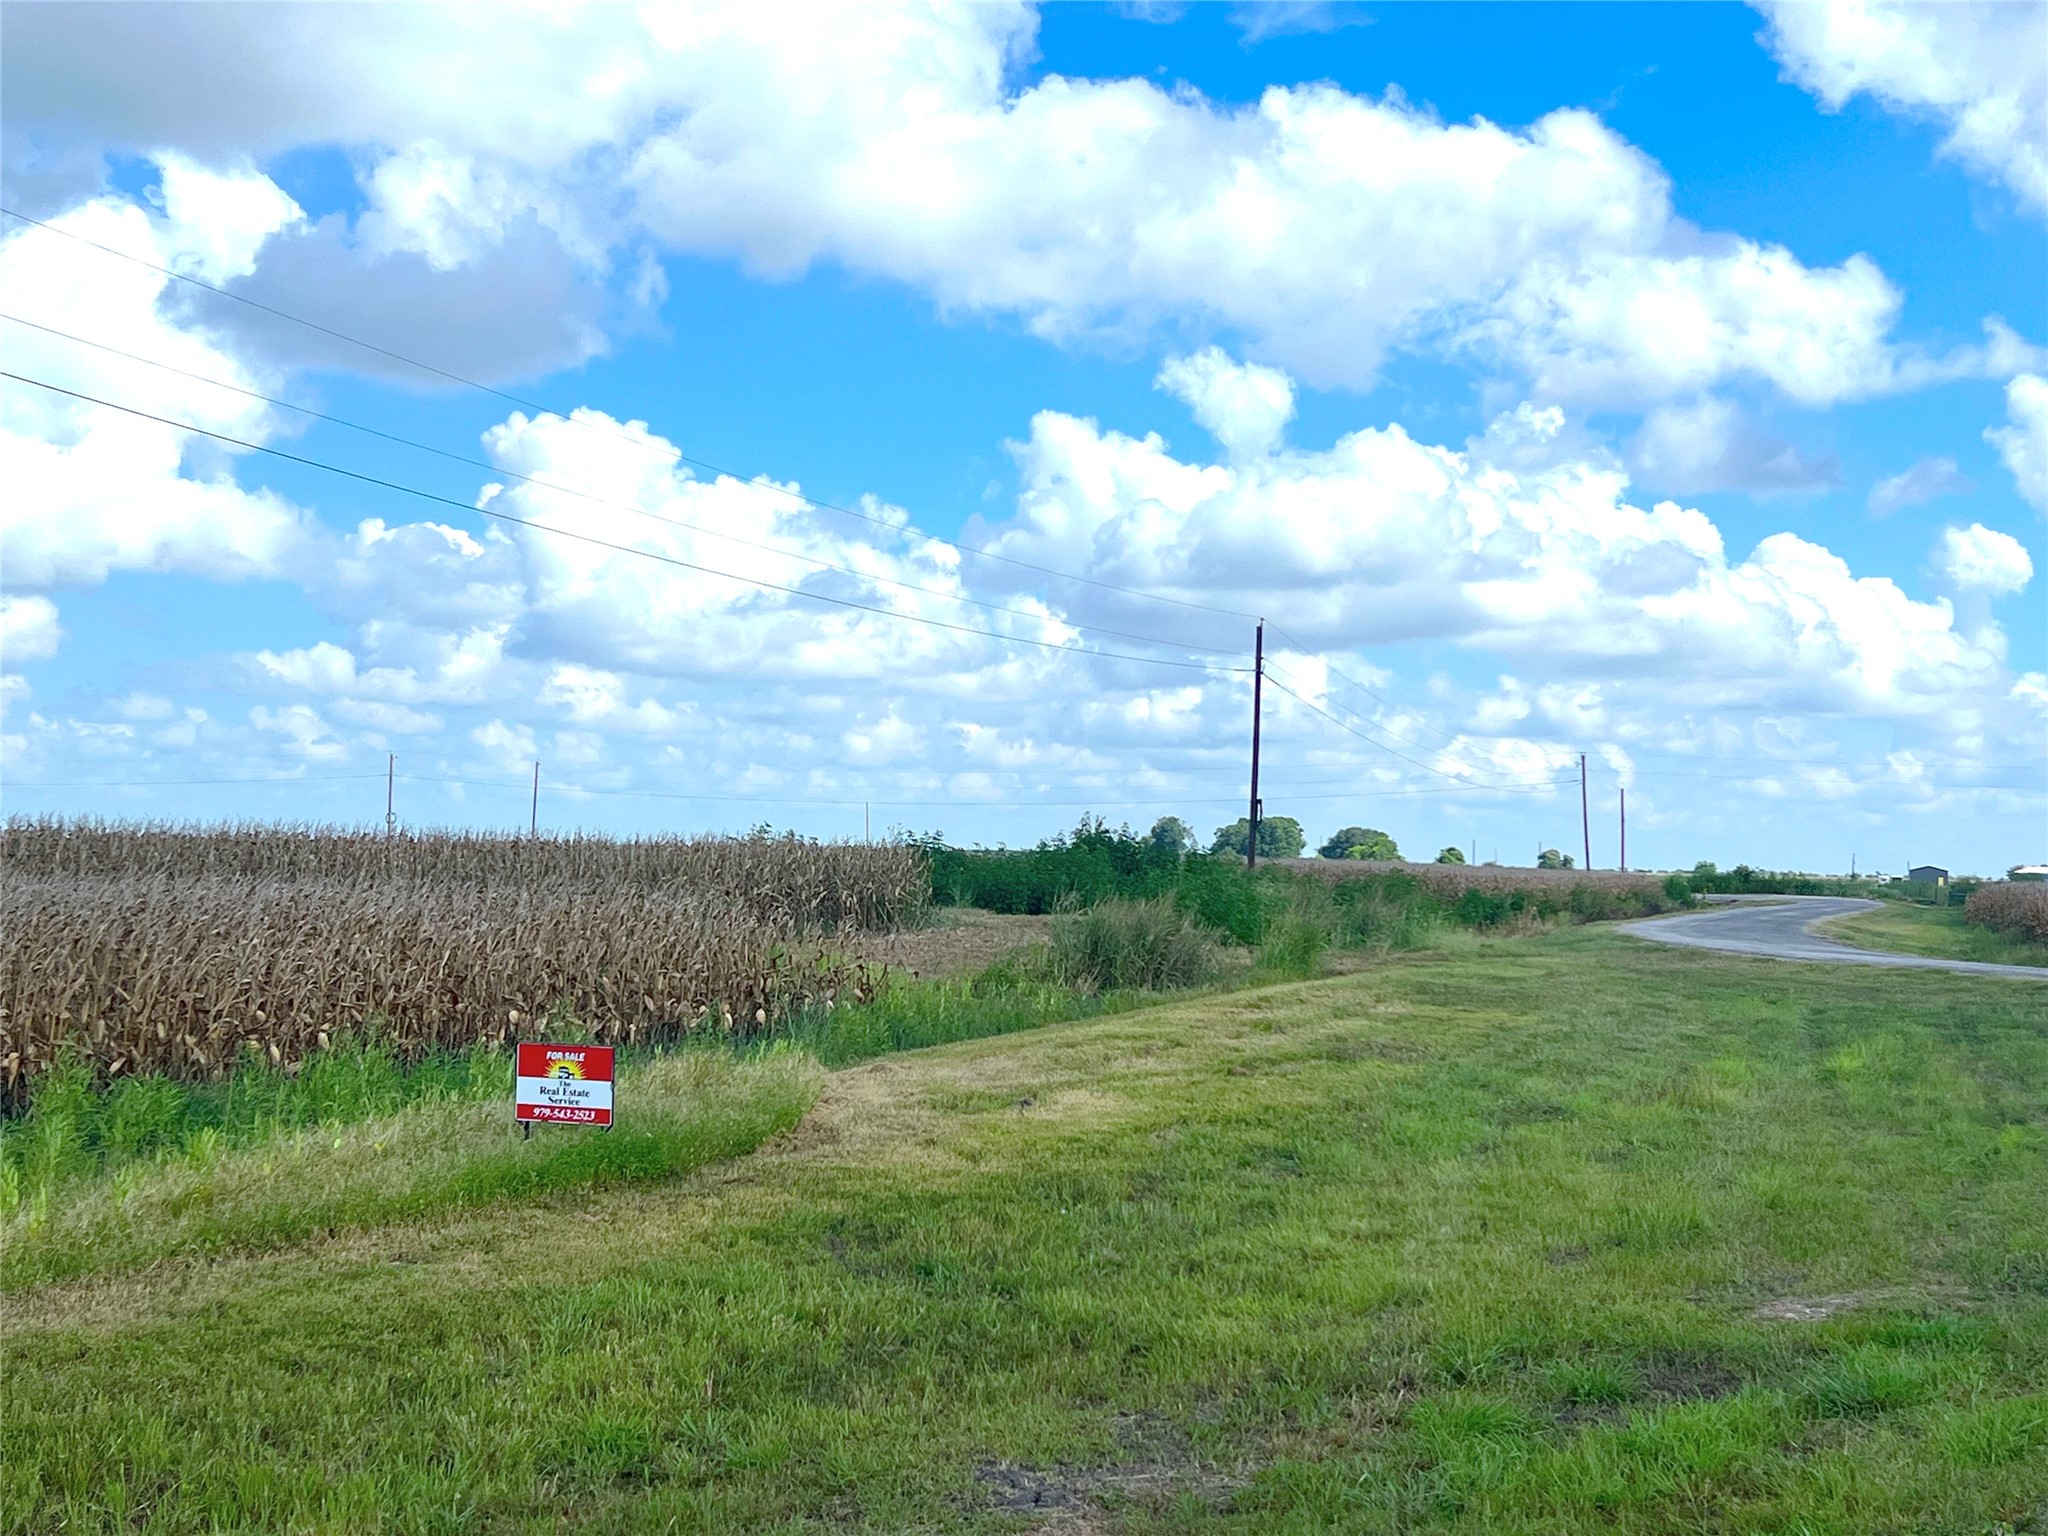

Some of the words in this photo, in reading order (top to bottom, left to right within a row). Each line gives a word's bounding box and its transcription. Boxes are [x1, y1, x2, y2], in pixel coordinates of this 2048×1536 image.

[546, 1051, 563, 1060] FOR
[564, 1052, 586, 1061] SALE
[540, 1086, 560, 1096] Real
[562, 1087, 590, 1097] Estate
[548, 1096, 580, 1106] Service
